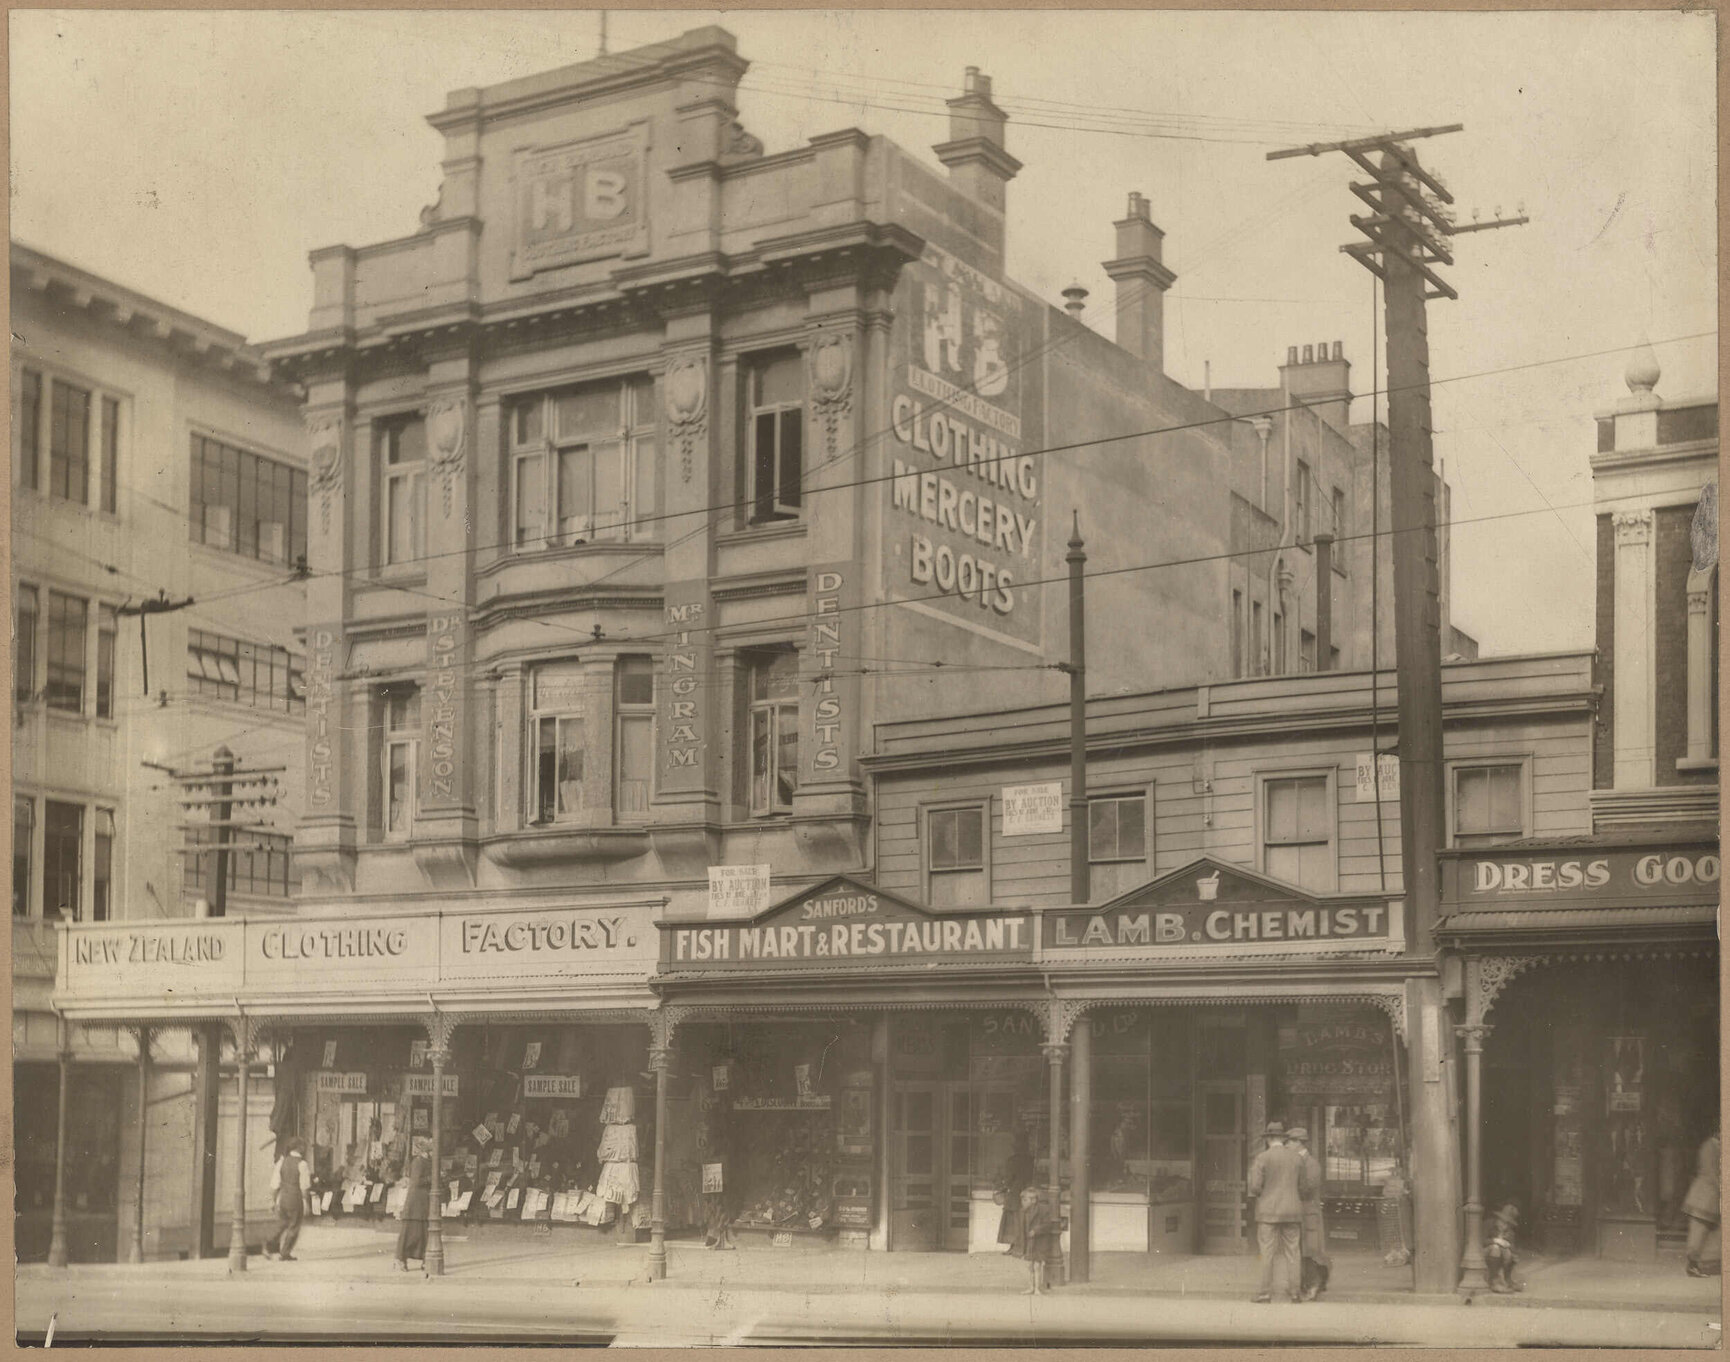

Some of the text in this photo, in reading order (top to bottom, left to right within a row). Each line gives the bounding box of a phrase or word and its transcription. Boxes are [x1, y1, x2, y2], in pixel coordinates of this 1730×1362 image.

[910, 532, 1014, 616] BOOTS
[813, 572, 844, 771] DENTISTS
[666, 630, 700, 768] INGRAM
[1473, 858, 1611, 893] DRESS
[801, 894, 878, 920] SANFORD'S
[1206, 907, 1384, 939] CHEMIST
[75, 937, 121, 964] NEW
[128, 934, 227, 963] ZEALAND
[261, 928, 408, 960] CLOTHING
[676, 918, 1025, 960] FISH MART & RESTAURANT
[320, 1076, 363, 1088] SAMPLE SALE
[409, 1080, 434, 1091] SAMPLE
[528, 1079, 576, 1093] SAMPLE SALE
